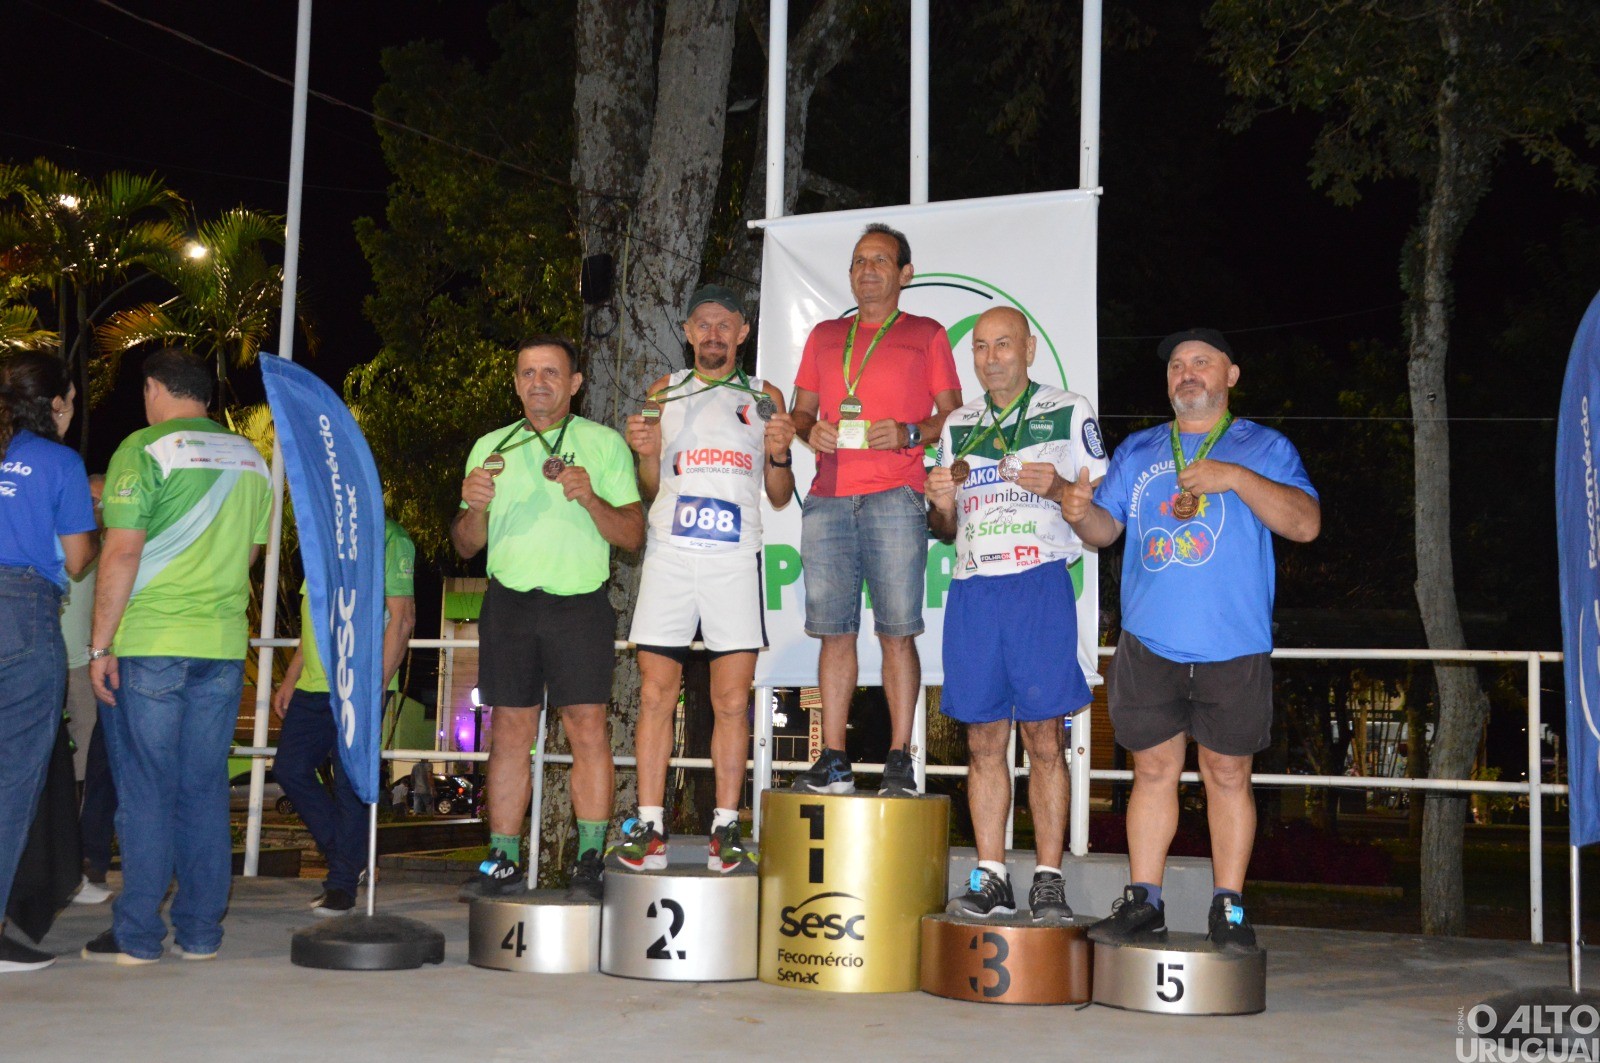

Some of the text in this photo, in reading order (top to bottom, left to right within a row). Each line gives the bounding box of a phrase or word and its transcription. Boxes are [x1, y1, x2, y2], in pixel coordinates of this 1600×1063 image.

[686, 448, 753, 471] KAPASS
[680, 506, 735, 532] 088
[977, 520, 1037, 537] Sicredi
[799, 804, 825, 884] 1
[501, 921, 527, 957] 4
[646, 898, 687, 960] 2
[777, 948, 864, 968] Fecomércio
[969, 931, 1011, 998] 3
[777, 967, 819, 985] Senac
[1156, 962, 1185, 1003] 5
